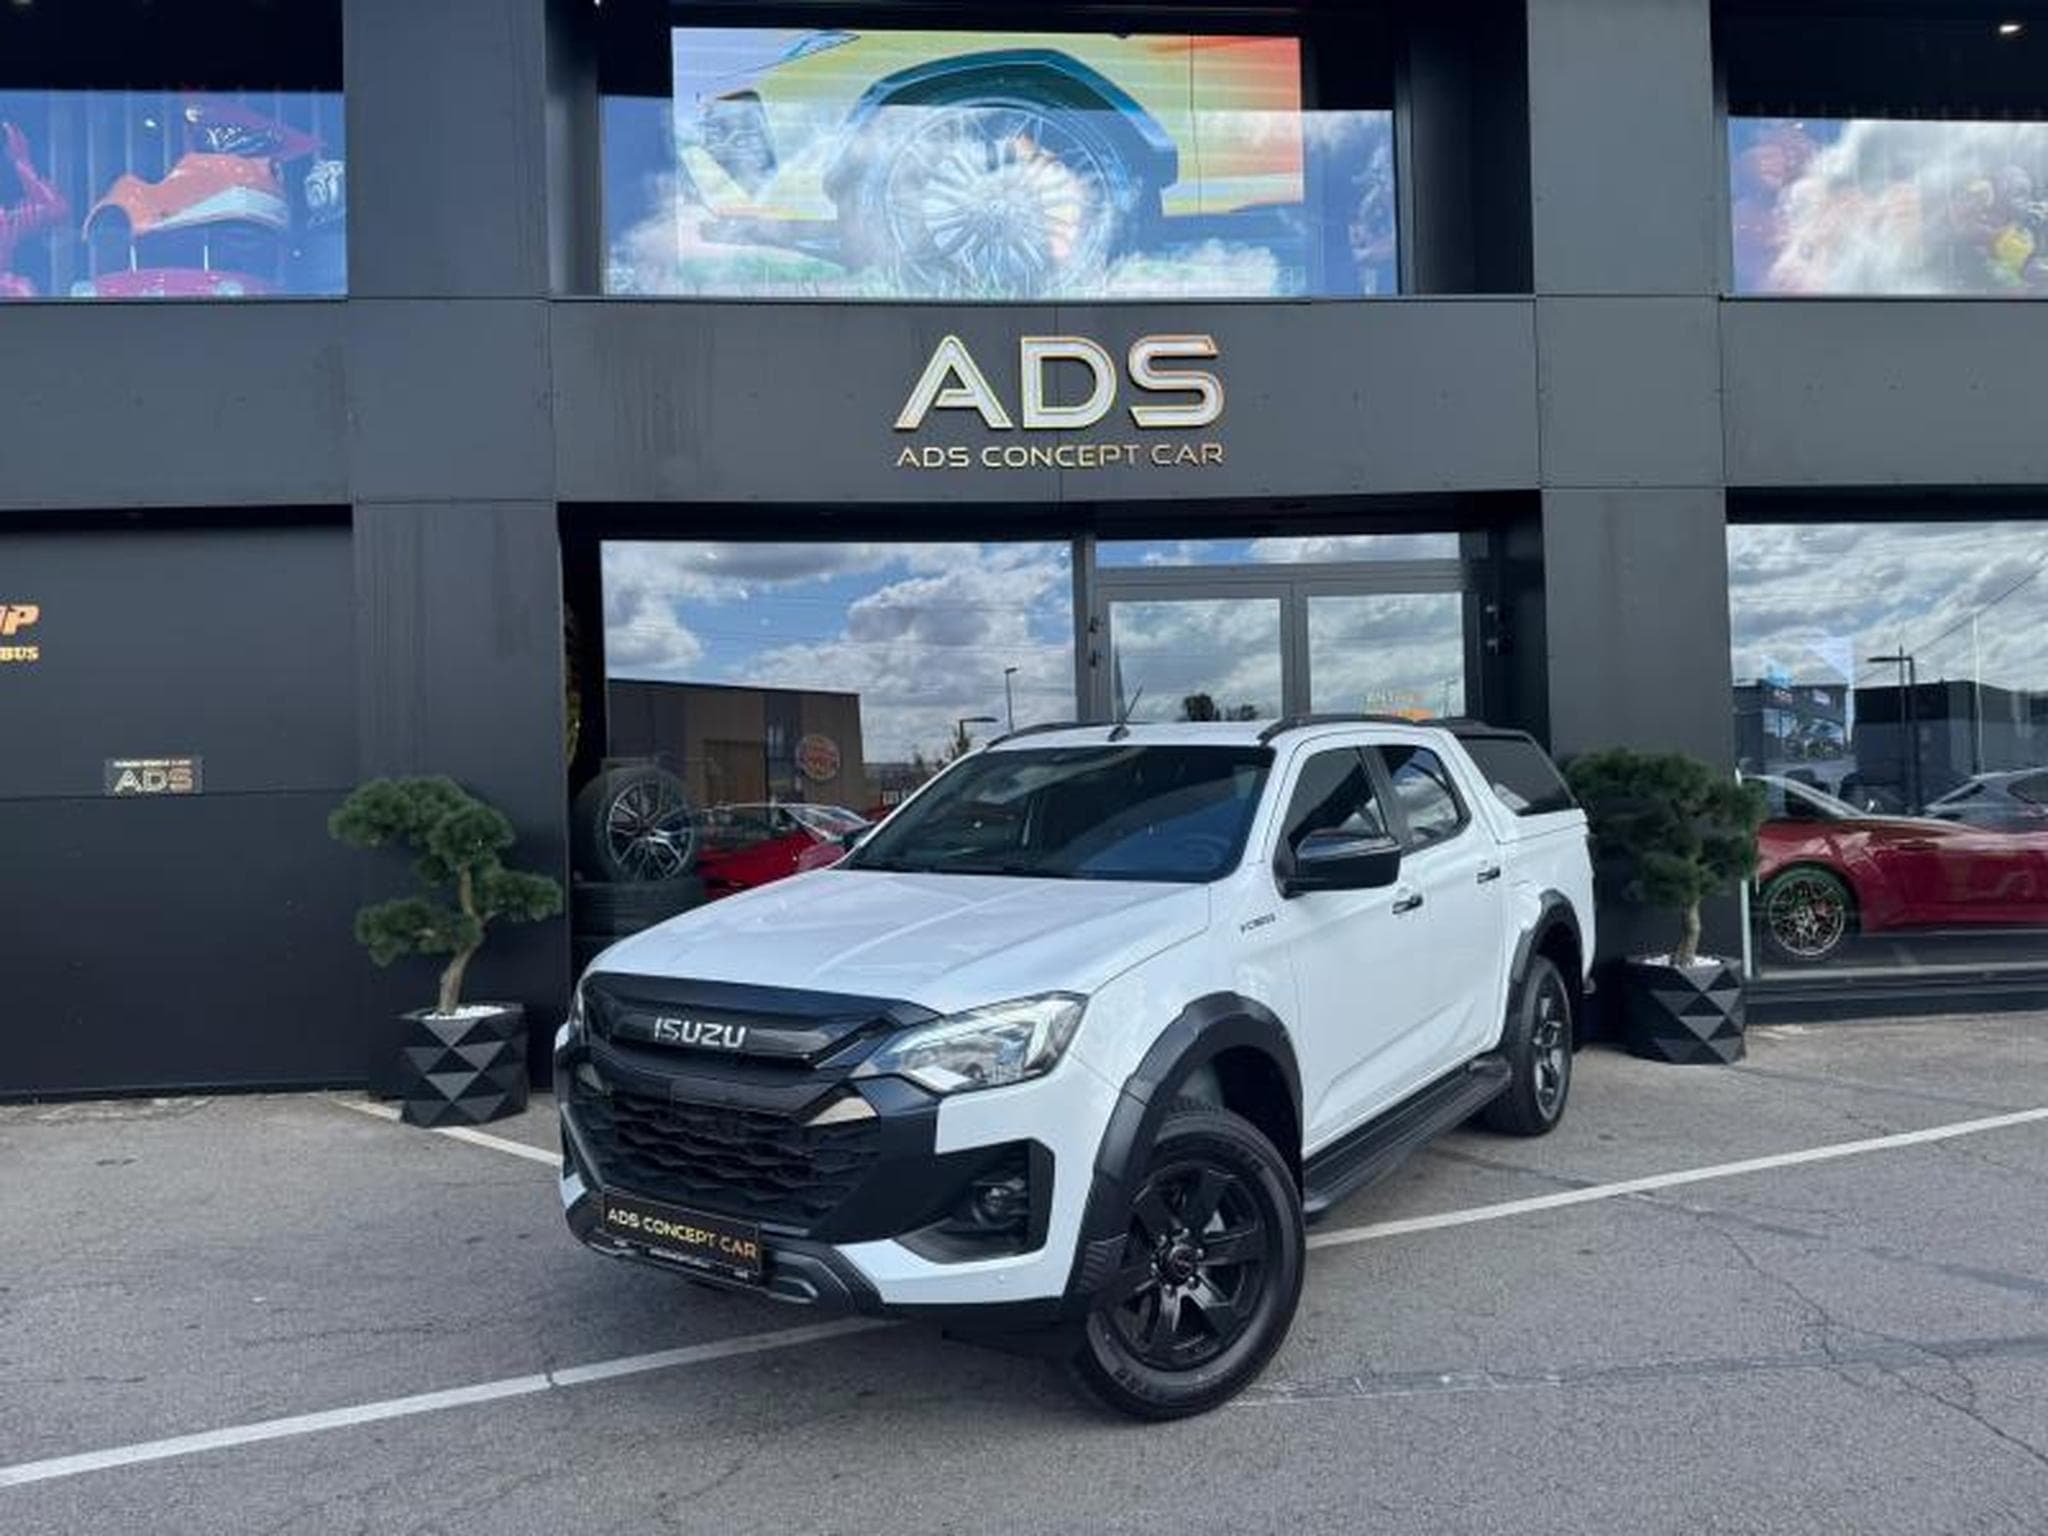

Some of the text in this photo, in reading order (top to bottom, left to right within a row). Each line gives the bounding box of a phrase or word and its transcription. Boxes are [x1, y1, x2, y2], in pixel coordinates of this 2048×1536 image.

[894, 335, 1225, 430] ADS
[897, 443, 1224, 468] ADS CONCEPT CAR
[0, 605, 40, 635] P
[114, 768, 193, 793] ADS
[654, 1017, 746, 1048] ISUZU
[607, 1208, 640, 1228] ADS
[643, 1217, 715, 1247] CONCEPT
[719, 1236, 757, 1259] CAR
